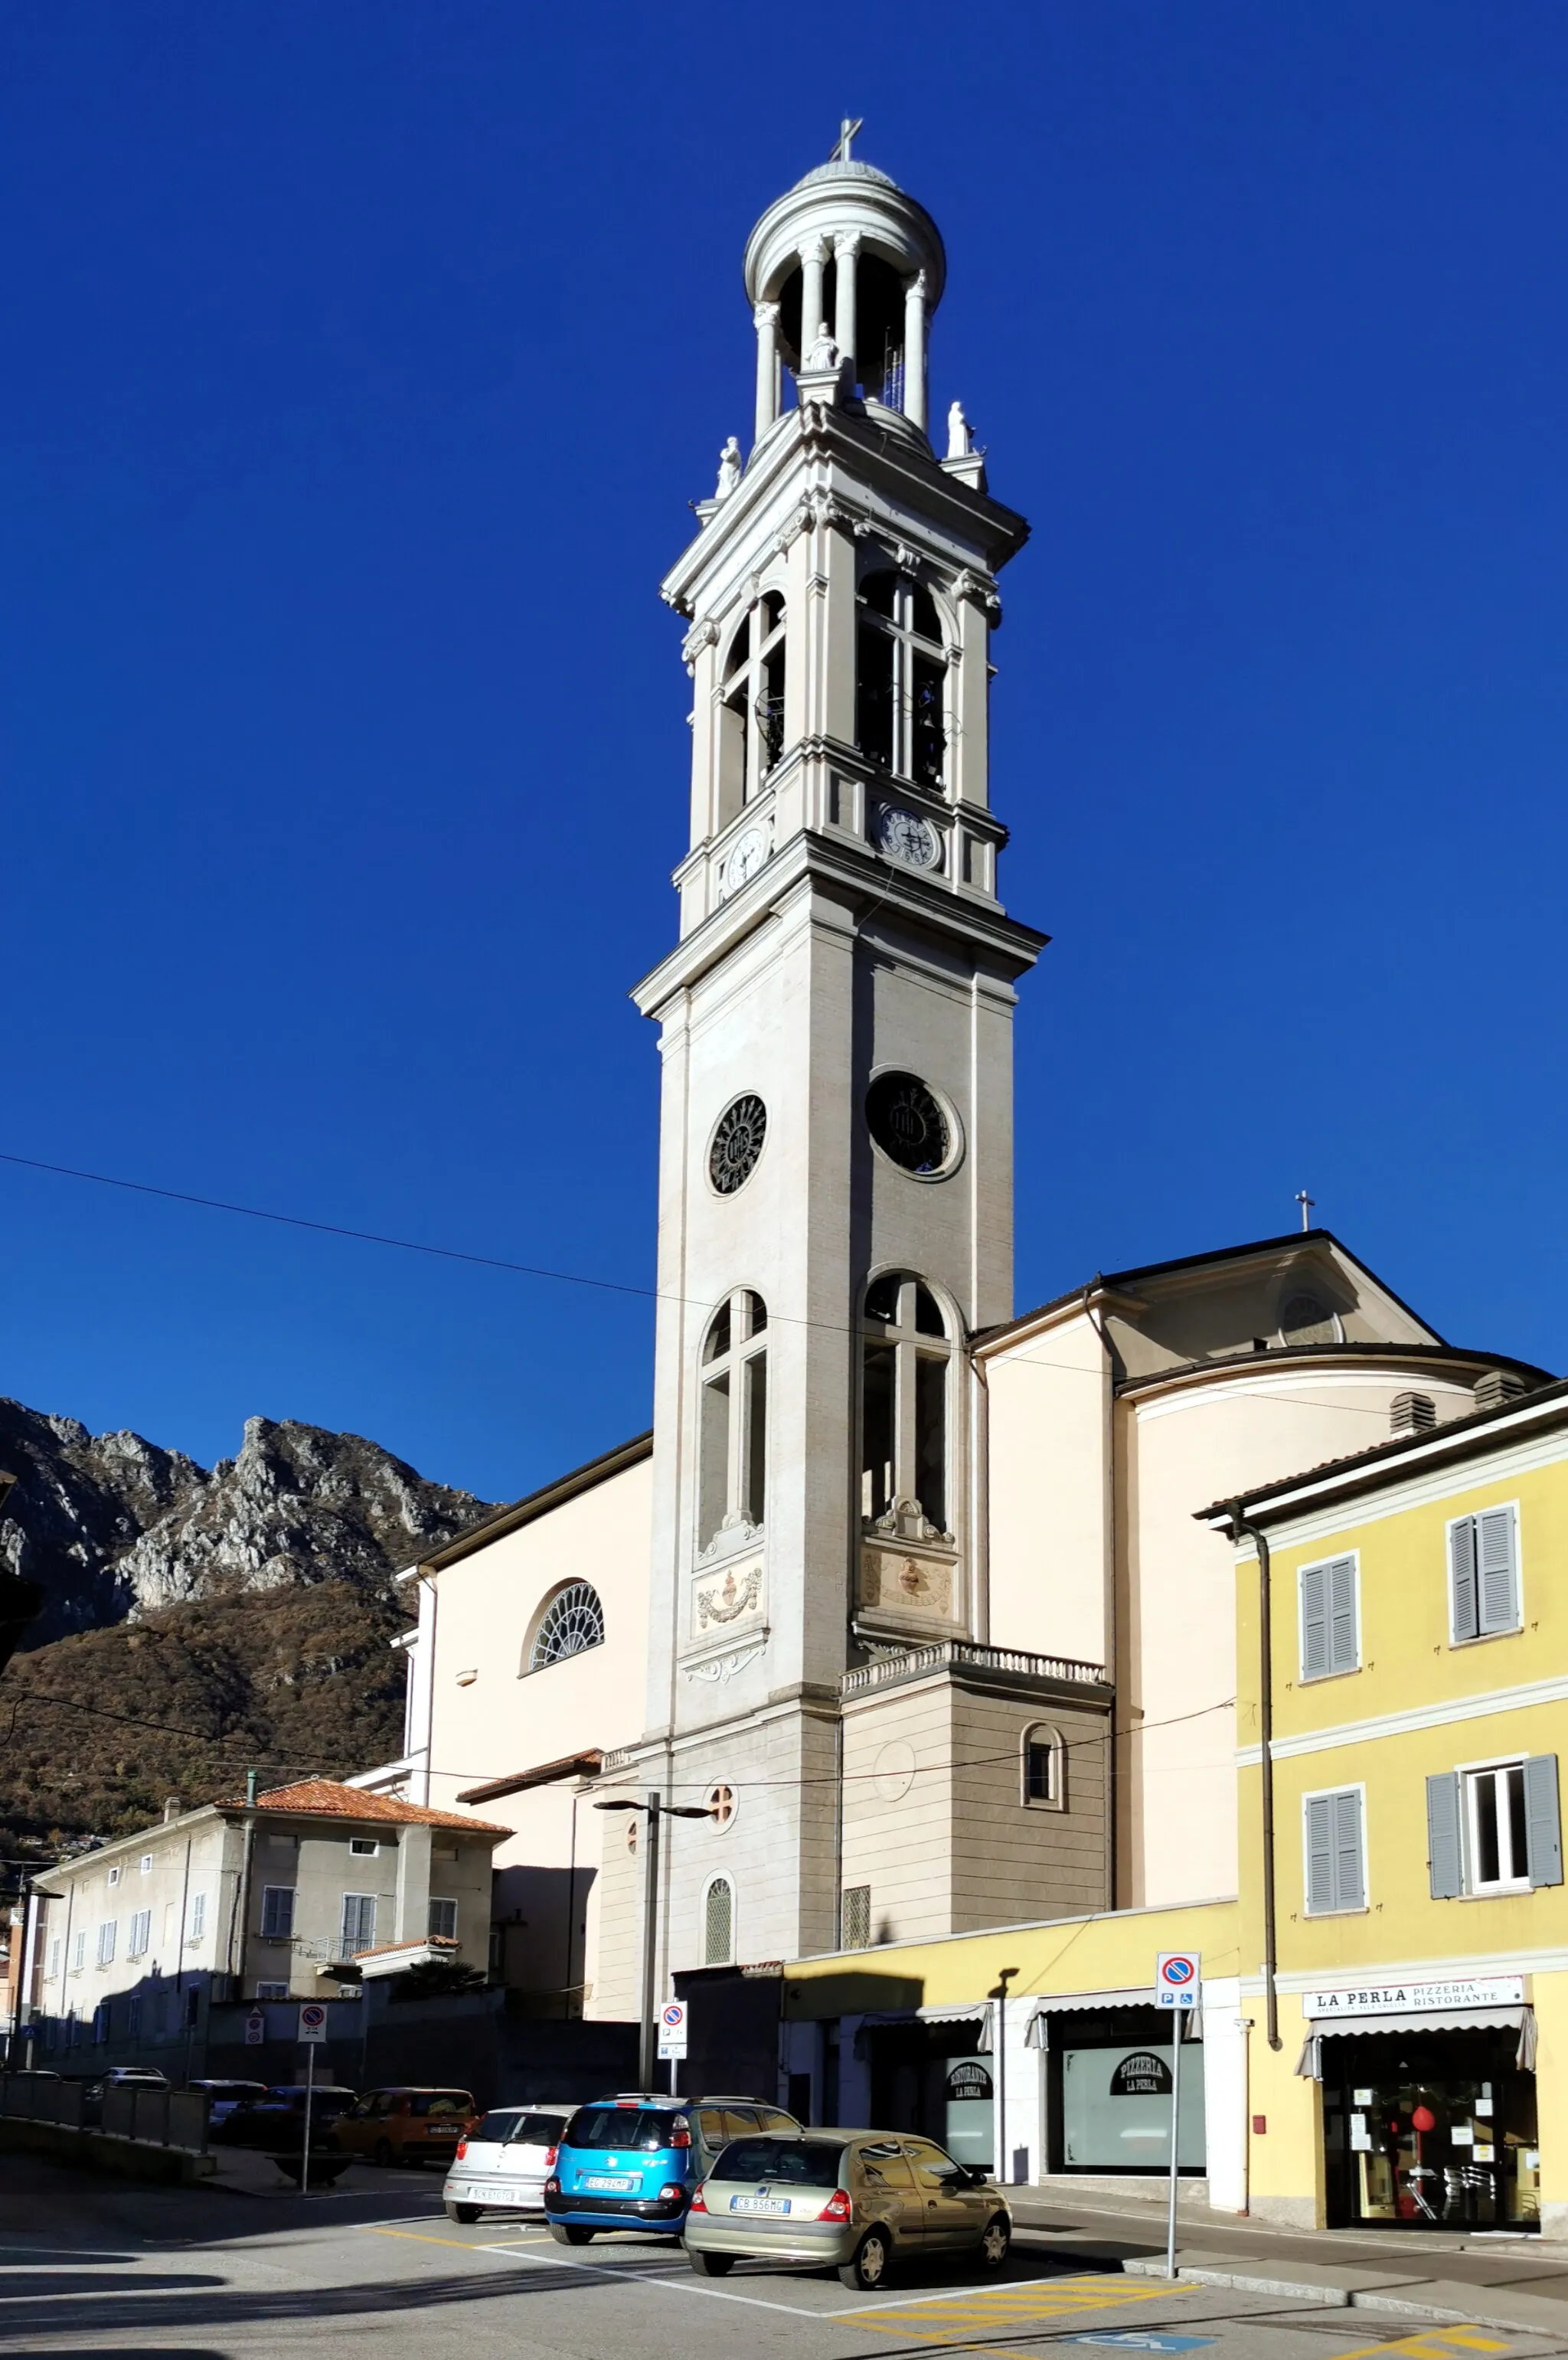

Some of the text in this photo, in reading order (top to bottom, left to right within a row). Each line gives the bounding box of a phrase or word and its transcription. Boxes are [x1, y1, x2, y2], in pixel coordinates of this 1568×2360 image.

[1413, 1984, 1475, 1996] PIZZERIA
[1317, 1989, 1407, 2007] LA PERLA
[1413, 1992, 1498, 2006] RISTORANTE
[1120, 2055, 1163, 2079] PIZZERIA
[950, 2066, 987, 2086] RISTORANTE
[1126, 2078, 1158, 2091] LA PERLA
[956, 2087, 963, 2097] LA
[738, 2198, 782, 2211] CB 856MG
